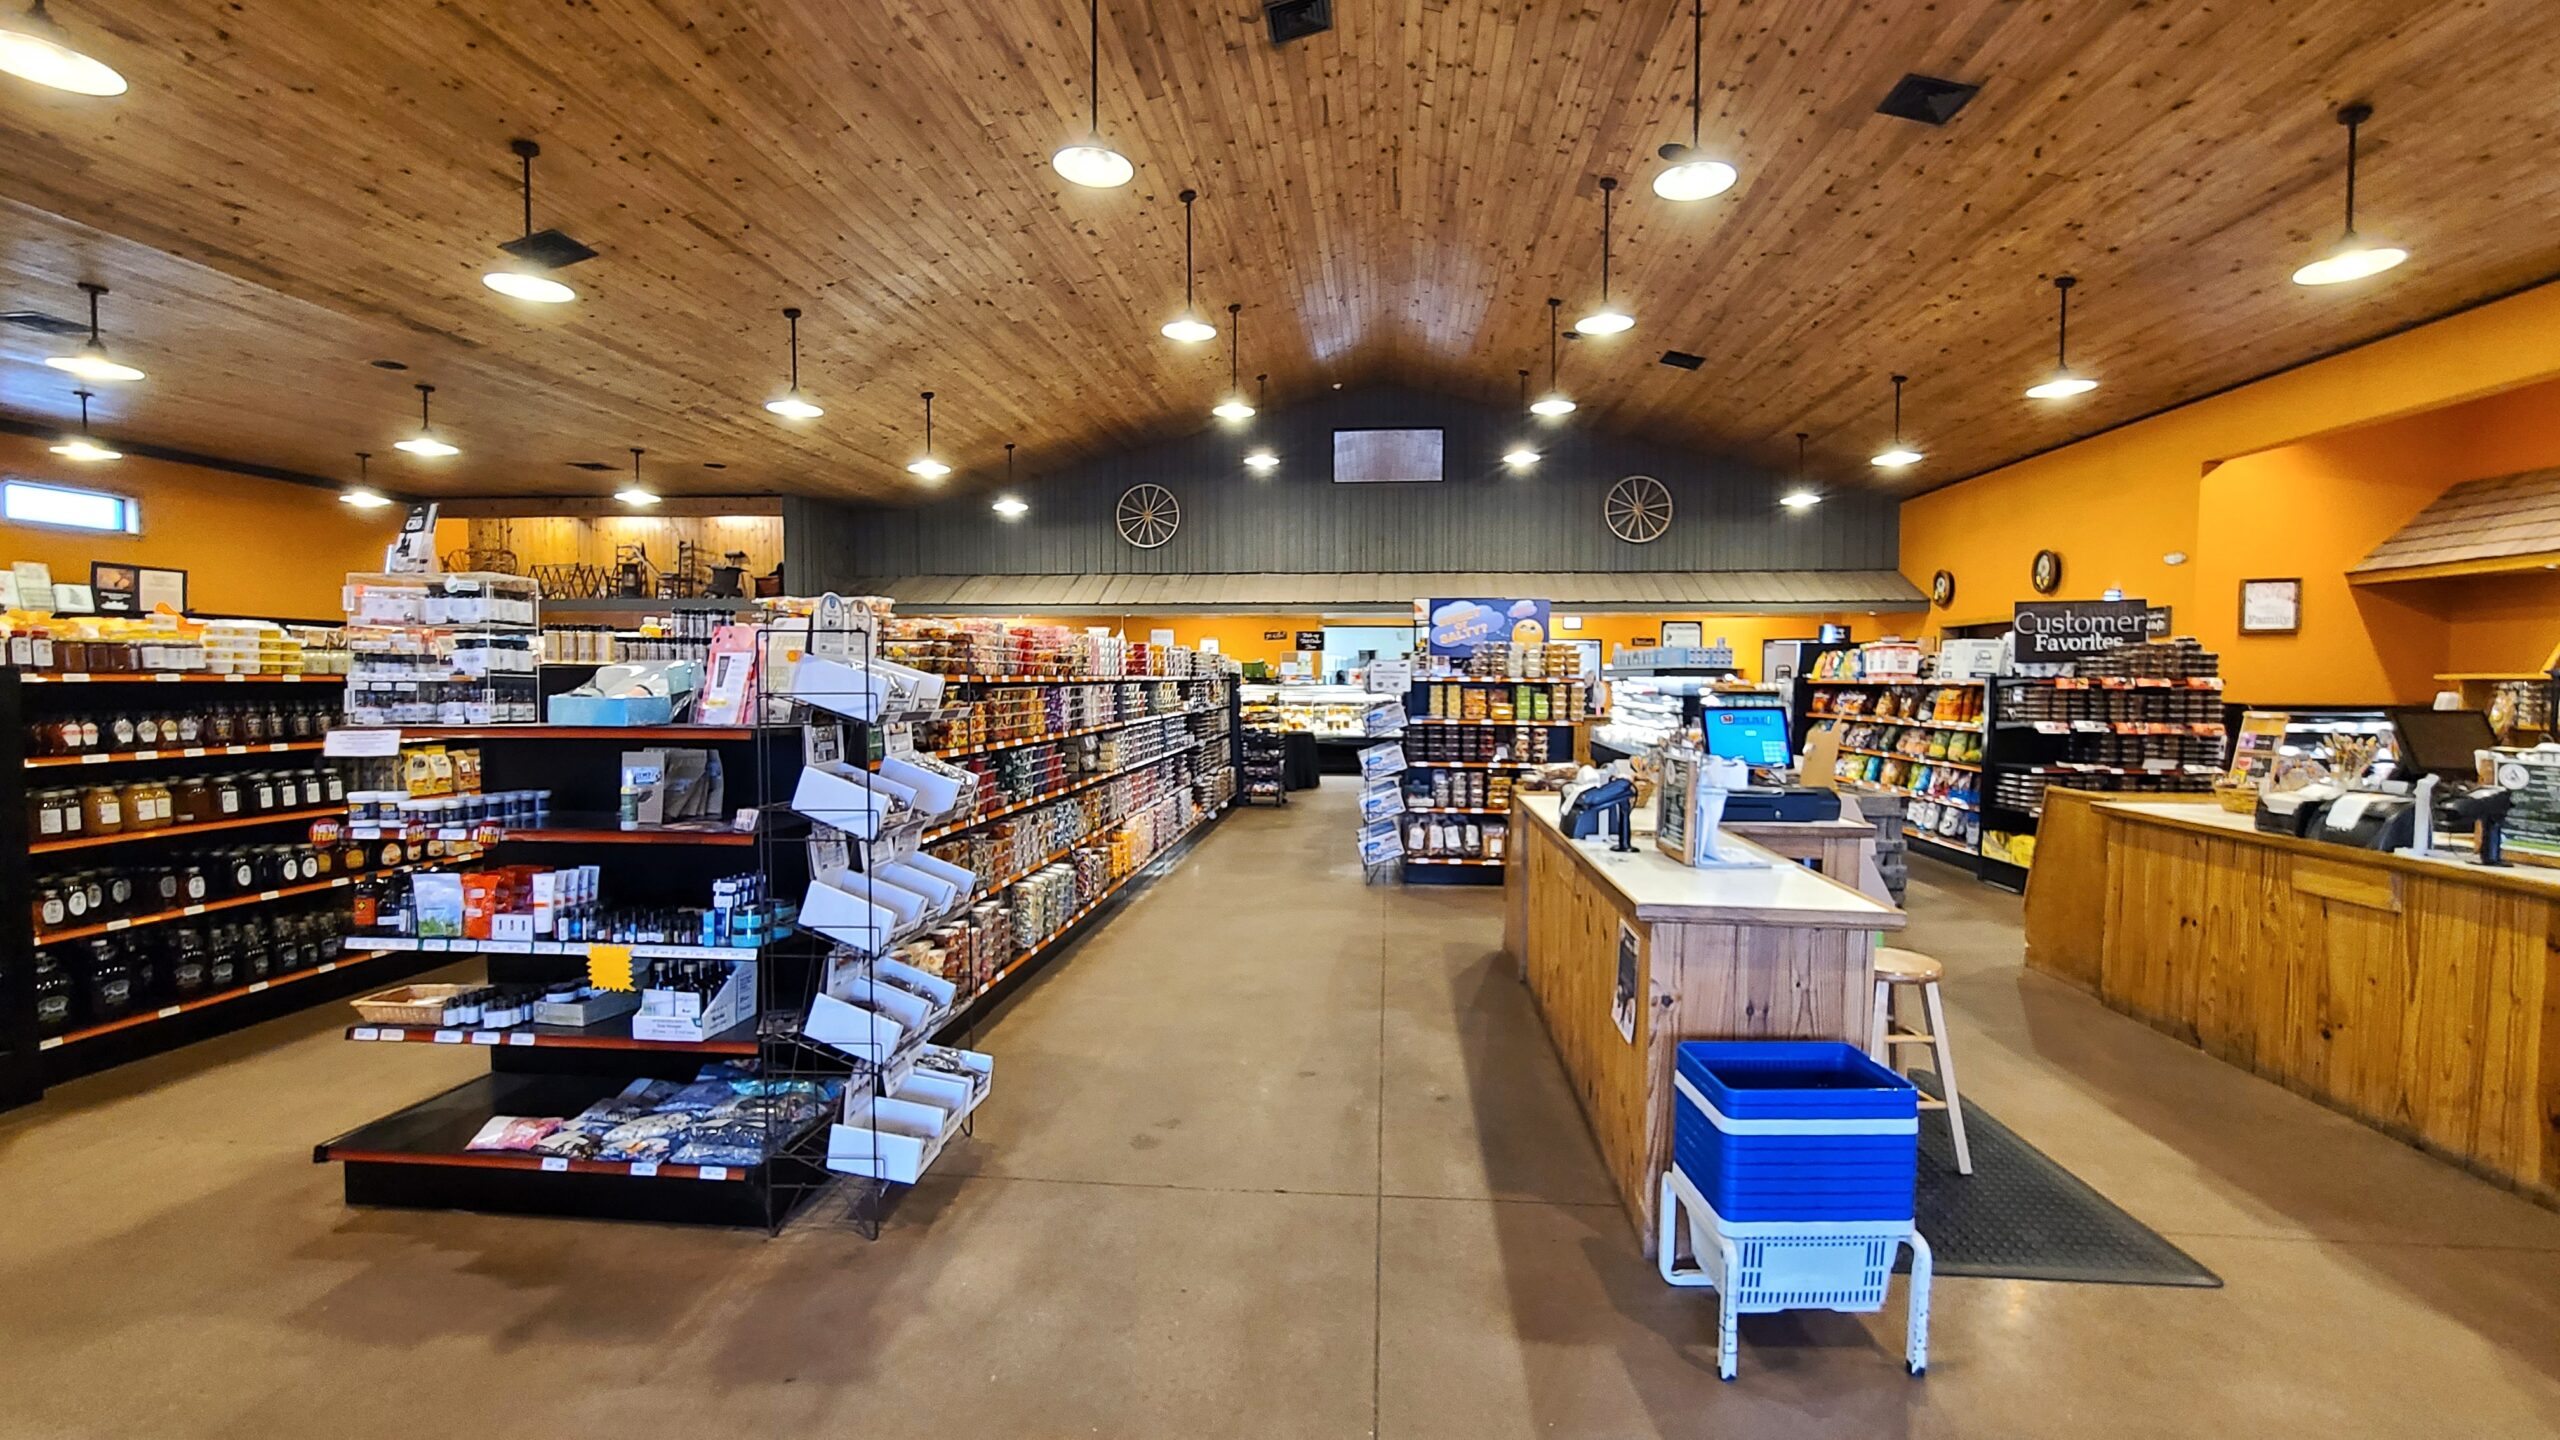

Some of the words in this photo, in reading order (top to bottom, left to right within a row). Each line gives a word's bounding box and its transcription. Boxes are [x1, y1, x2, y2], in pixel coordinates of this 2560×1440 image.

[2015, 610, 2147, 635] Customer
[2034, 633, 2124, 652] Favorites
[313, 824, 339, 835] NEW
[481, 825, 501, 836] NEW
[313, 832, 338, 842] ITEM
